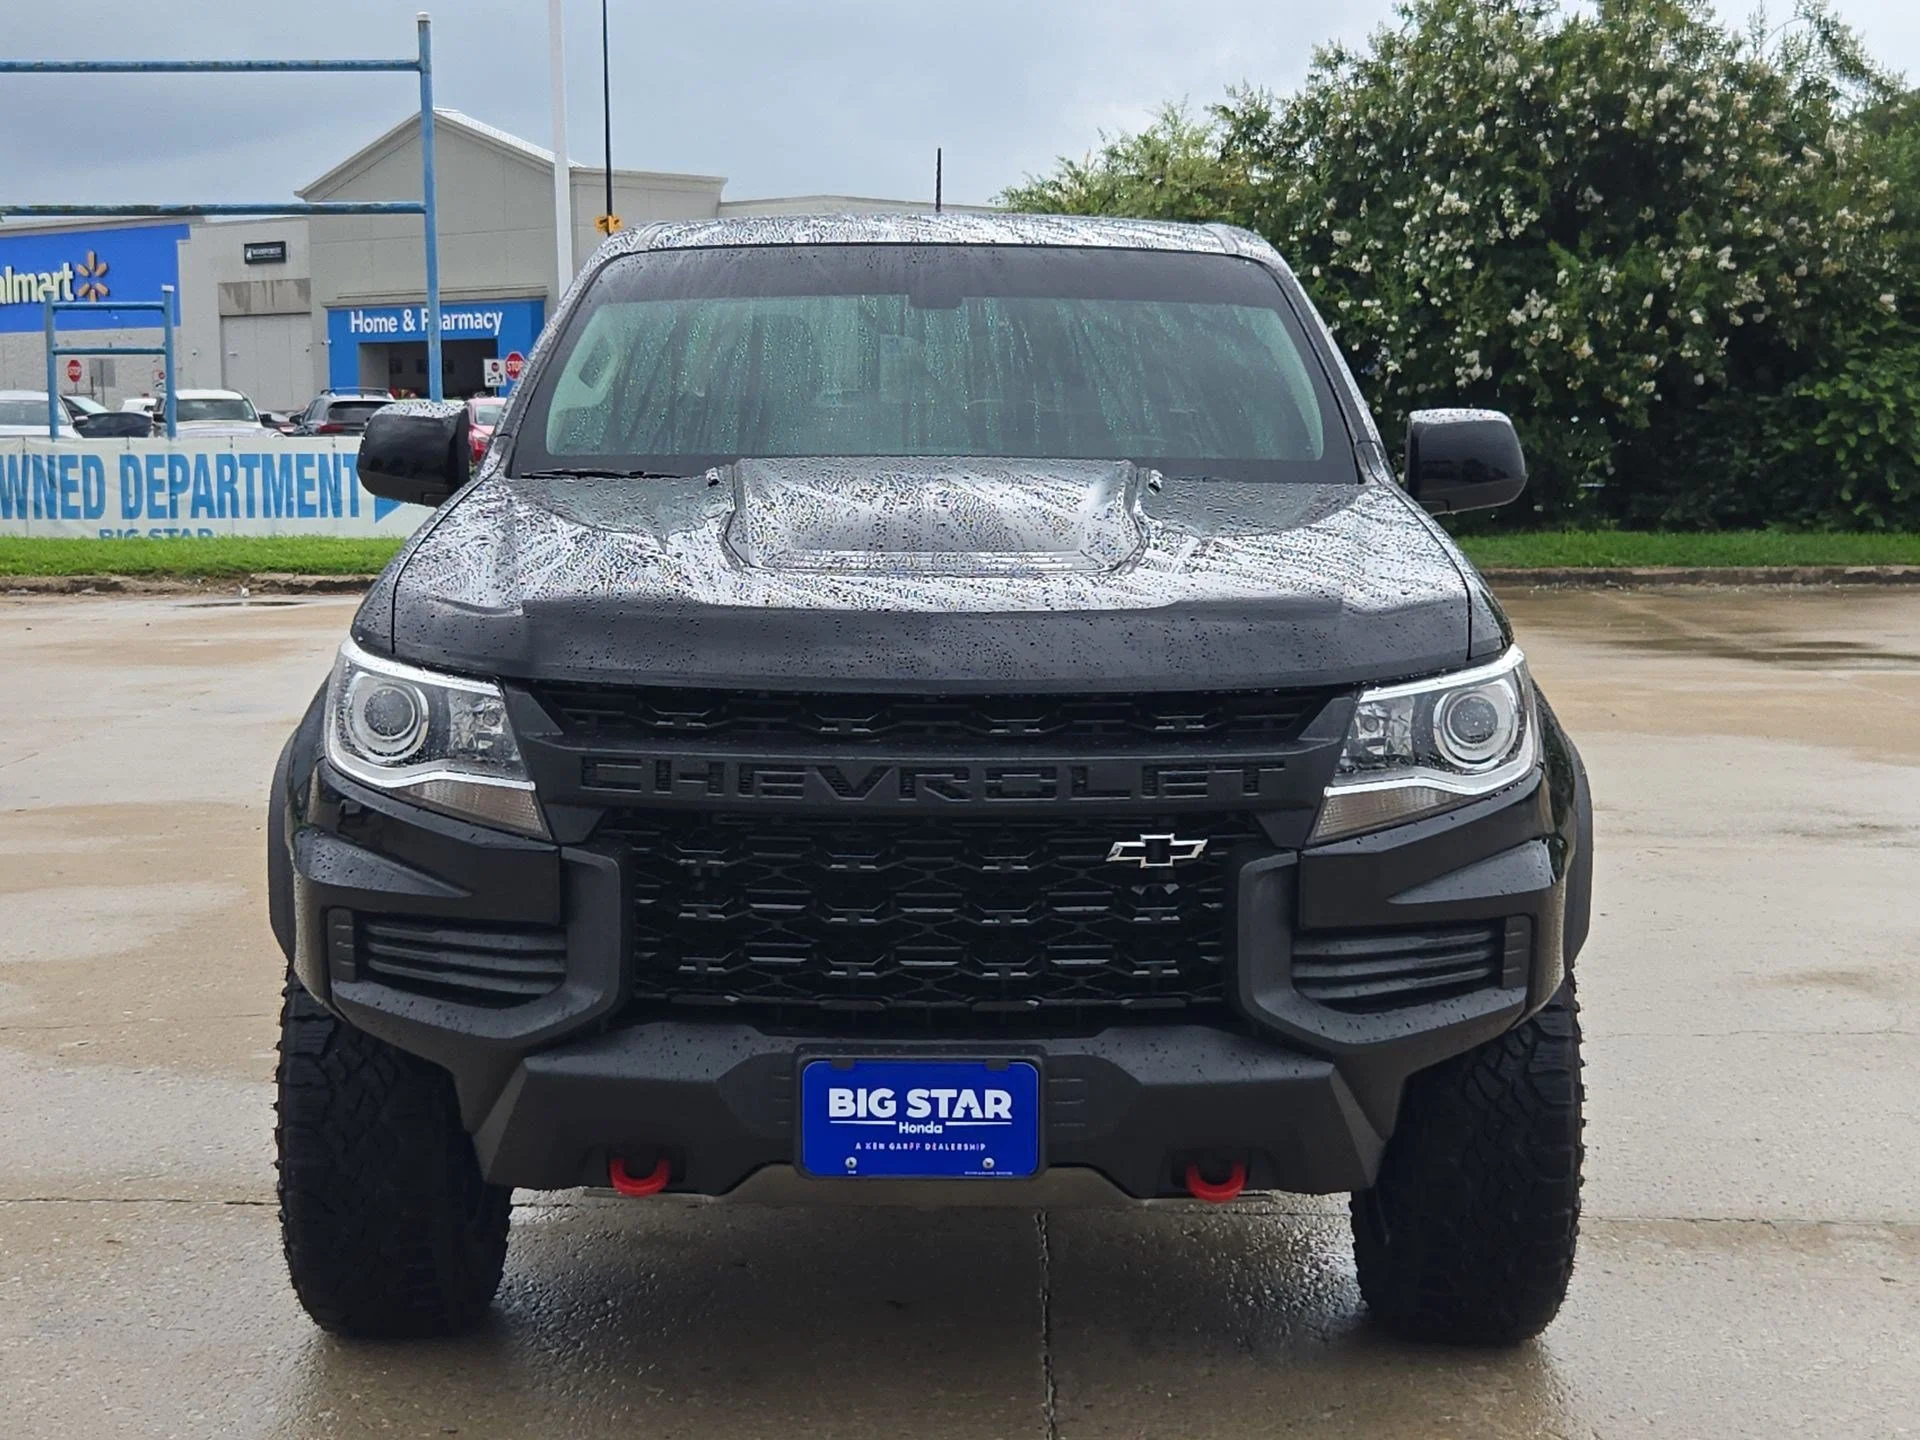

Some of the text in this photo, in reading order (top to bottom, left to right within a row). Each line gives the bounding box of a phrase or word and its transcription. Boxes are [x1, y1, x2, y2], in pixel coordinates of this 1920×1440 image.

[350, 307, 503, 336] Home & Parmacy
[119, 453, 360, 520] DEPARTMENT
[580, 755, 1286, 802] CHEVROLET
[828, 1088, 1012, 1119] BIG STAR
[898, 1120, 943, 1135] Honda
[855, 1142, 986, 1151] A KEN GARFF DEALERSHIP
